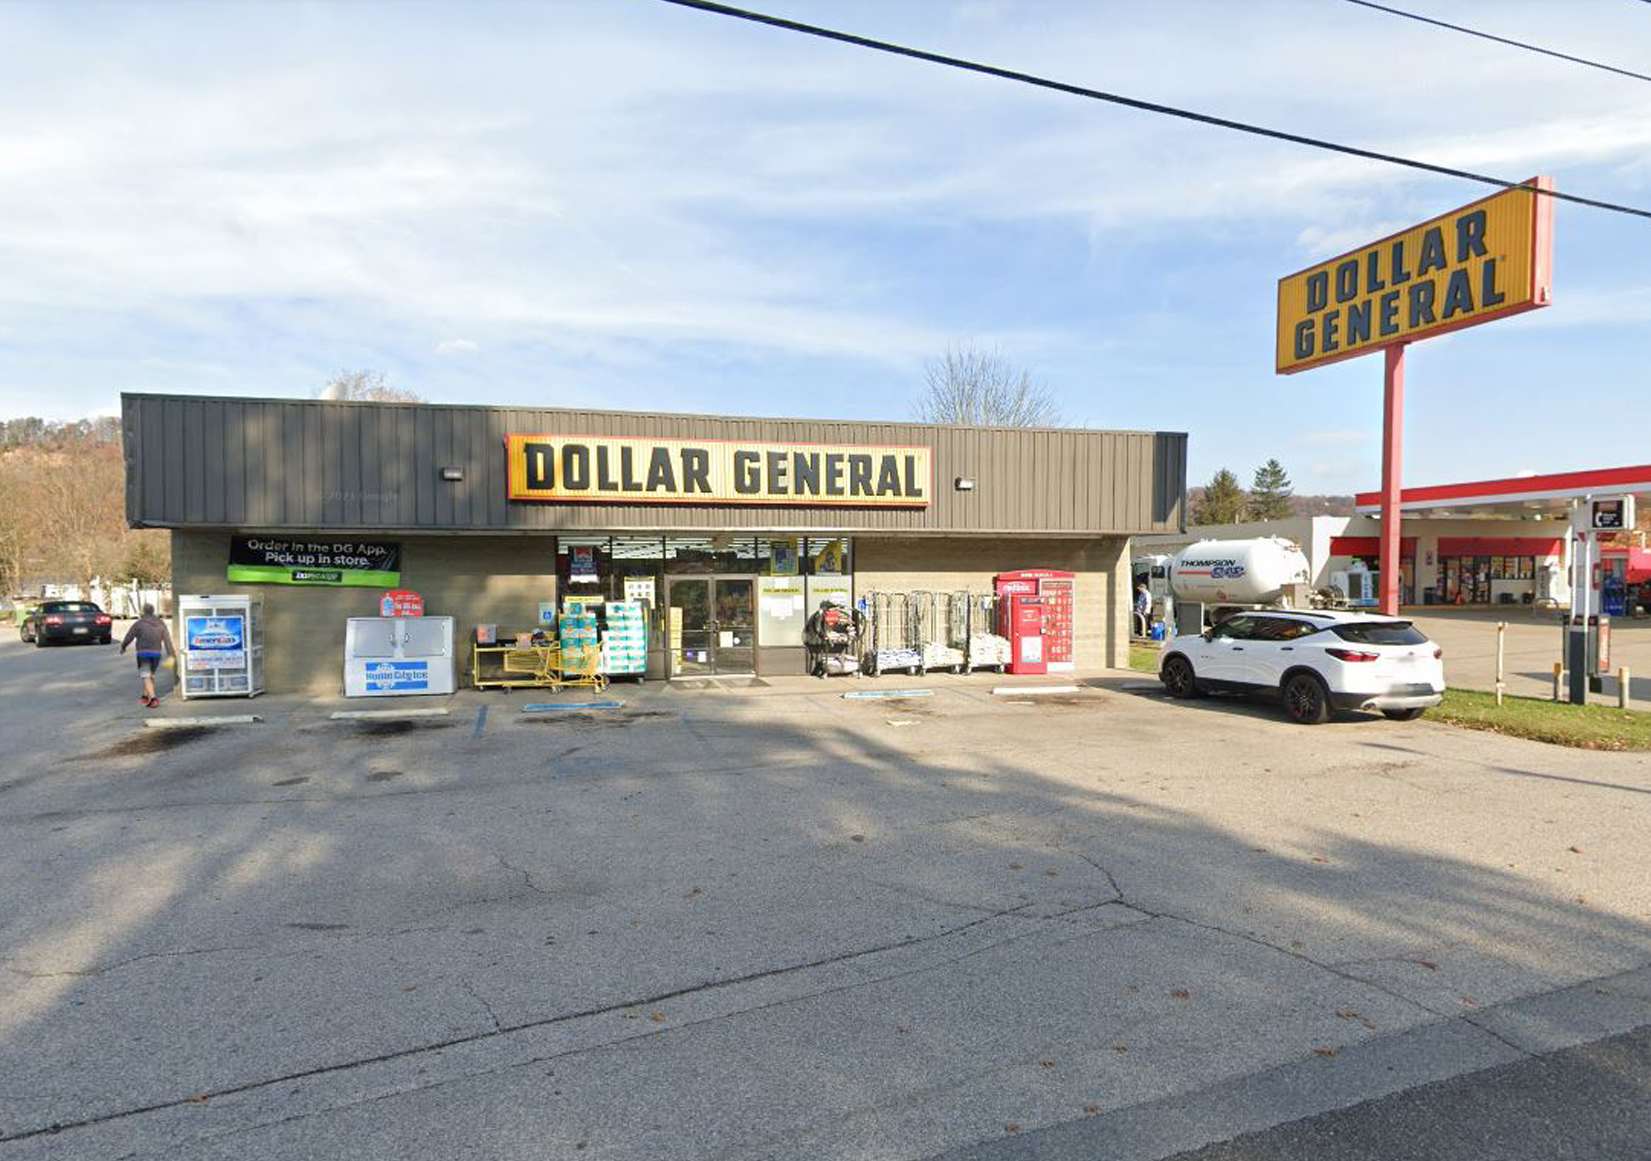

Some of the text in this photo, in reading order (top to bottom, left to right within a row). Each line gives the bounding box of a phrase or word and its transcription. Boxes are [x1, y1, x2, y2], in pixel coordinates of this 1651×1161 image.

[1306, 209, 1488, 315] DOLLAR
[1294, 258, 1505, 360] GENERAL
[524, 442, 924, 498] DOLLAR GENERAL
[247, 539, 387, 556] Order in the DG App.
[265, 551, 371, 567] Pick up in store.
[1181, 559, 1236, 567] THOMPSON
[413, 670, 429, 680] Ice
